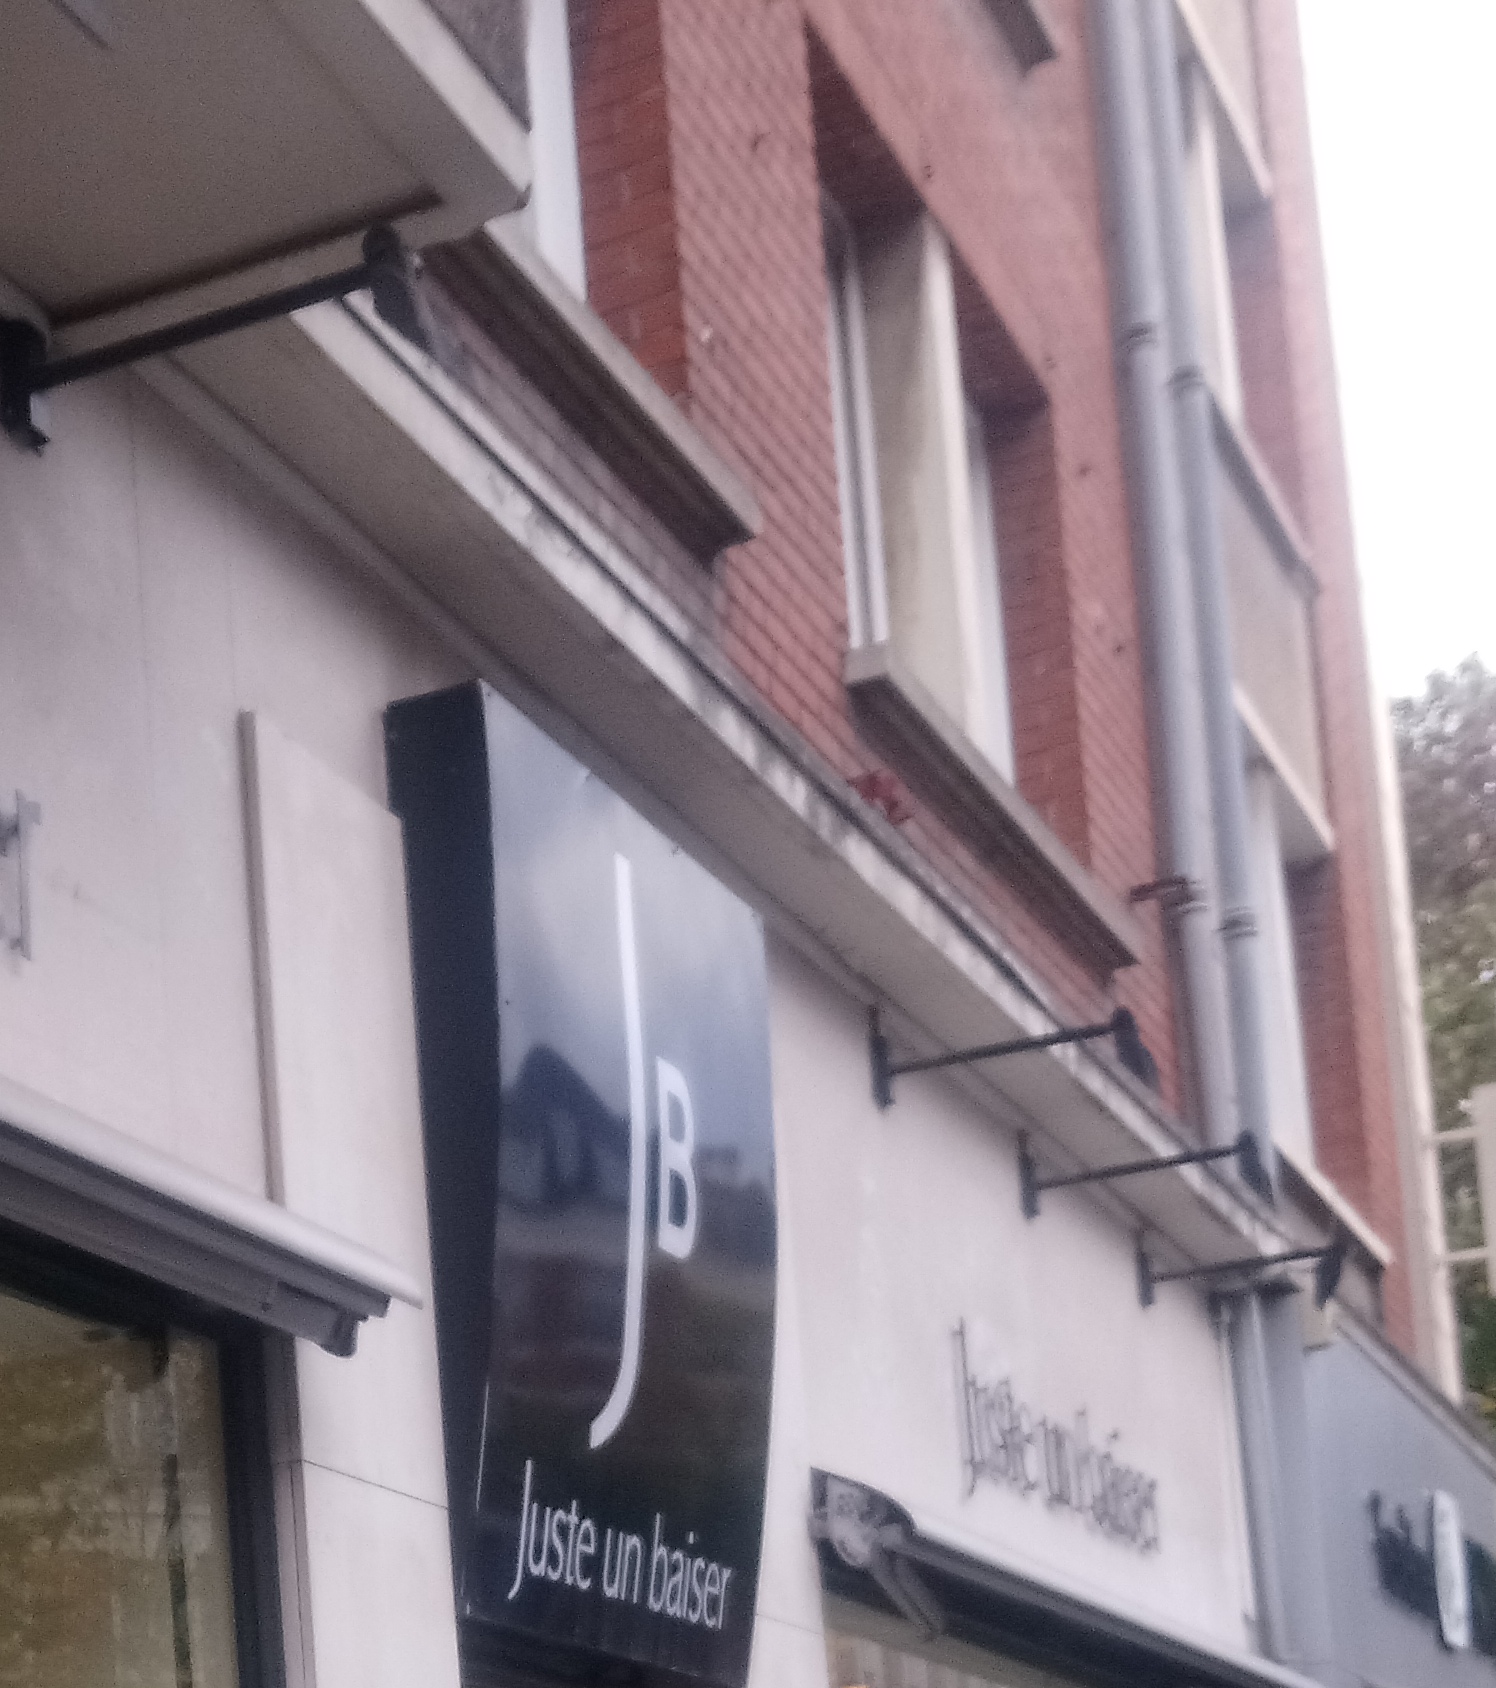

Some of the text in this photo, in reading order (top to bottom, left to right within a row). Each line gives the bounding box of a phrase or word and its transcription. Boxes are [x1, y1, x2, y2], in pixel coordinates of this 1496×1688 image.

[508, 1459, 732, 1630] Juste un baiser
